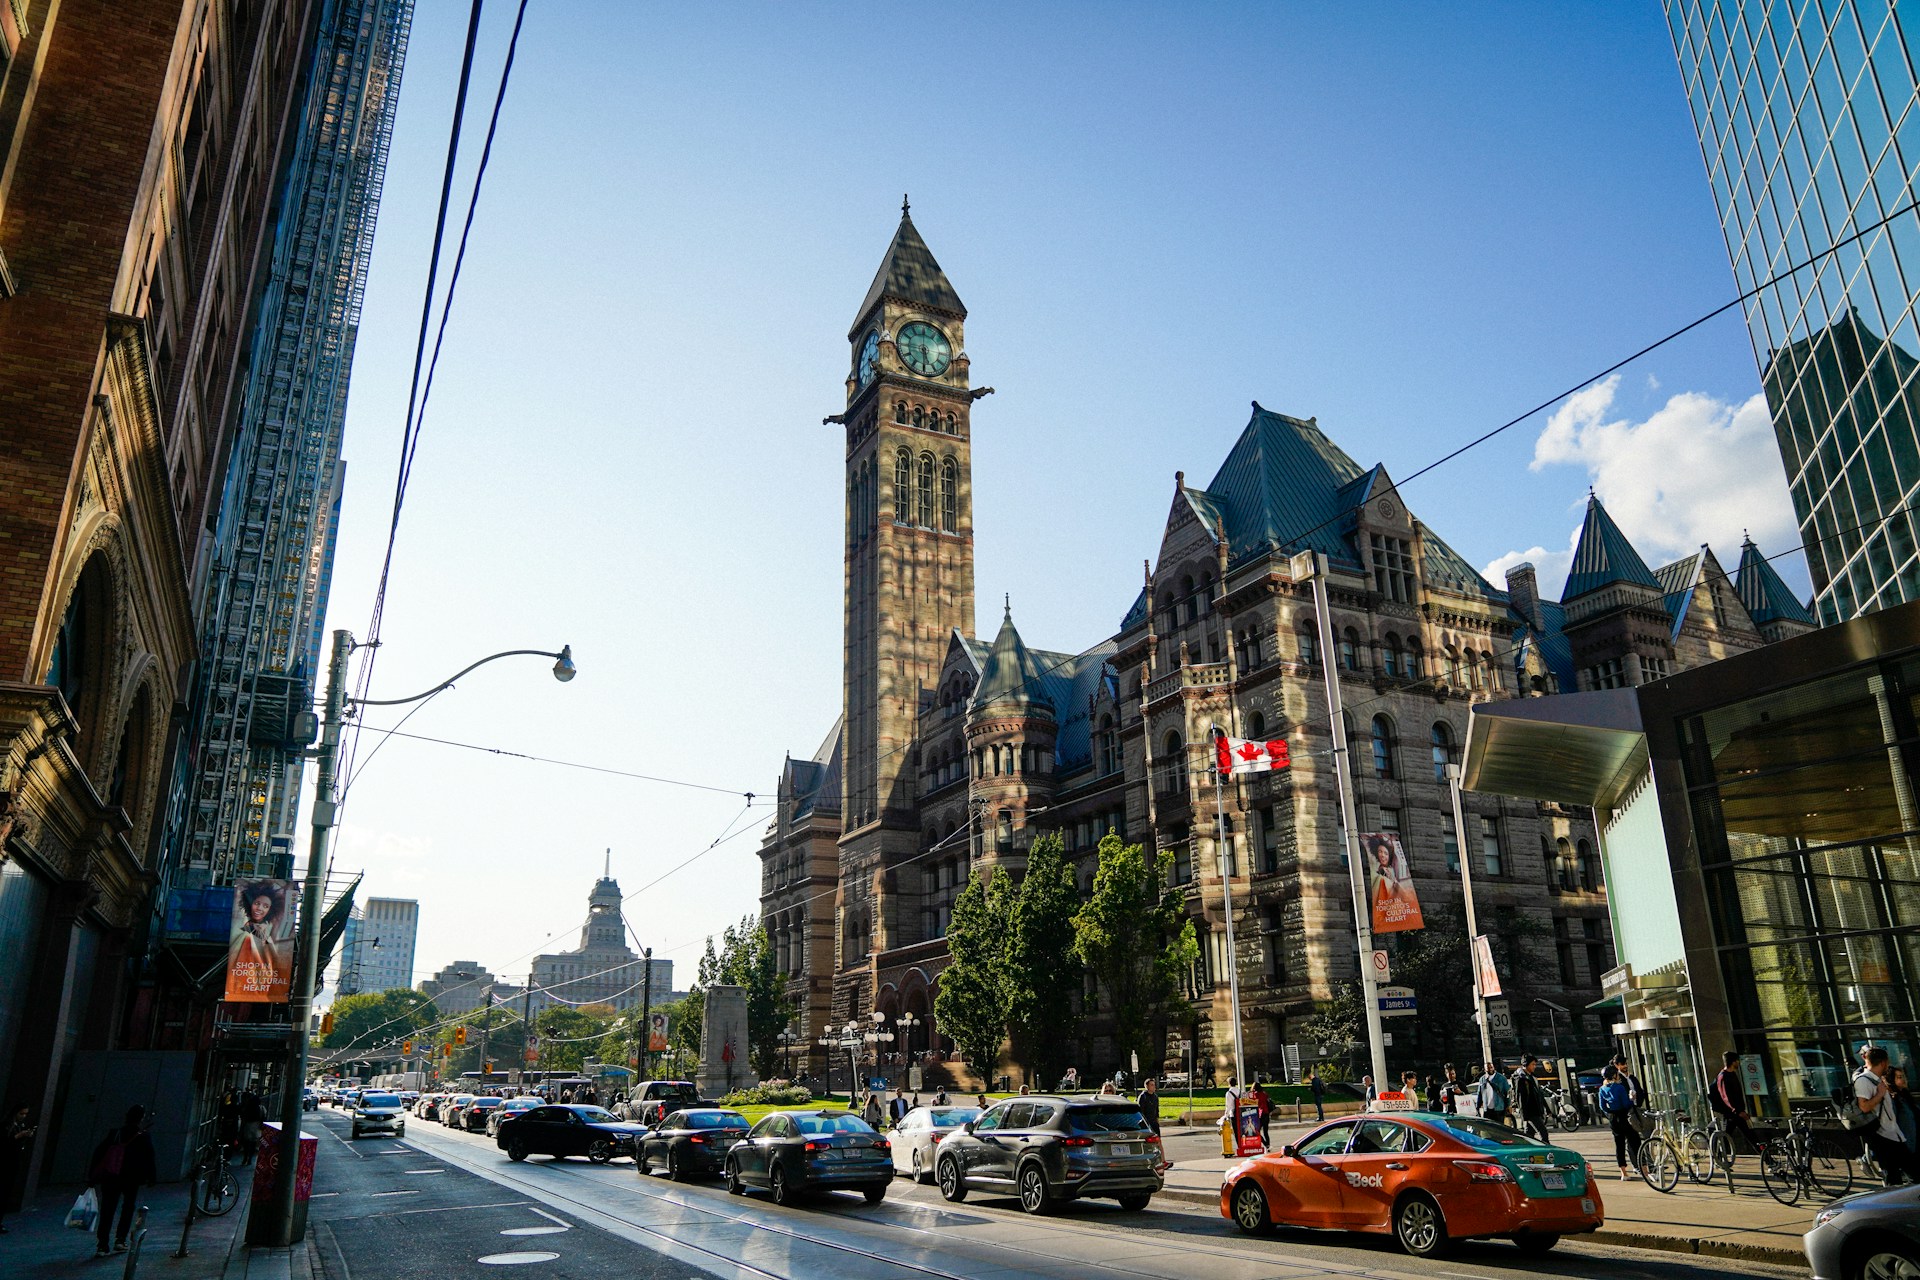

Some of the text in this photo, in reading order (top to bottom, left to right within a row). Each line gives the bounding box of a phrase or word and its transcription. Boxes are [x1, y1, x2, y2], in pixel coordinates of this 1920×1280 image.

[1376, 902, 1410, 912] TORONTO'S
[1386, 908, 1419, 917] CULTURAL
[1385, 915, 1407, 923] HEART
[236, 961, 260, 969] SHOP
[231, 969, 279, 977] TORONTO'S
[246, 977, 288, 985] CULTURAL
[243, 984, 271, 992] HEART
[1385, 999, 1405, 1009] James
[1493, 1013, 1509, 1027] 30
[1382, 1100, 1411, 1109] 751-5555
[1351, 1172, 1384, 1188] Beck
